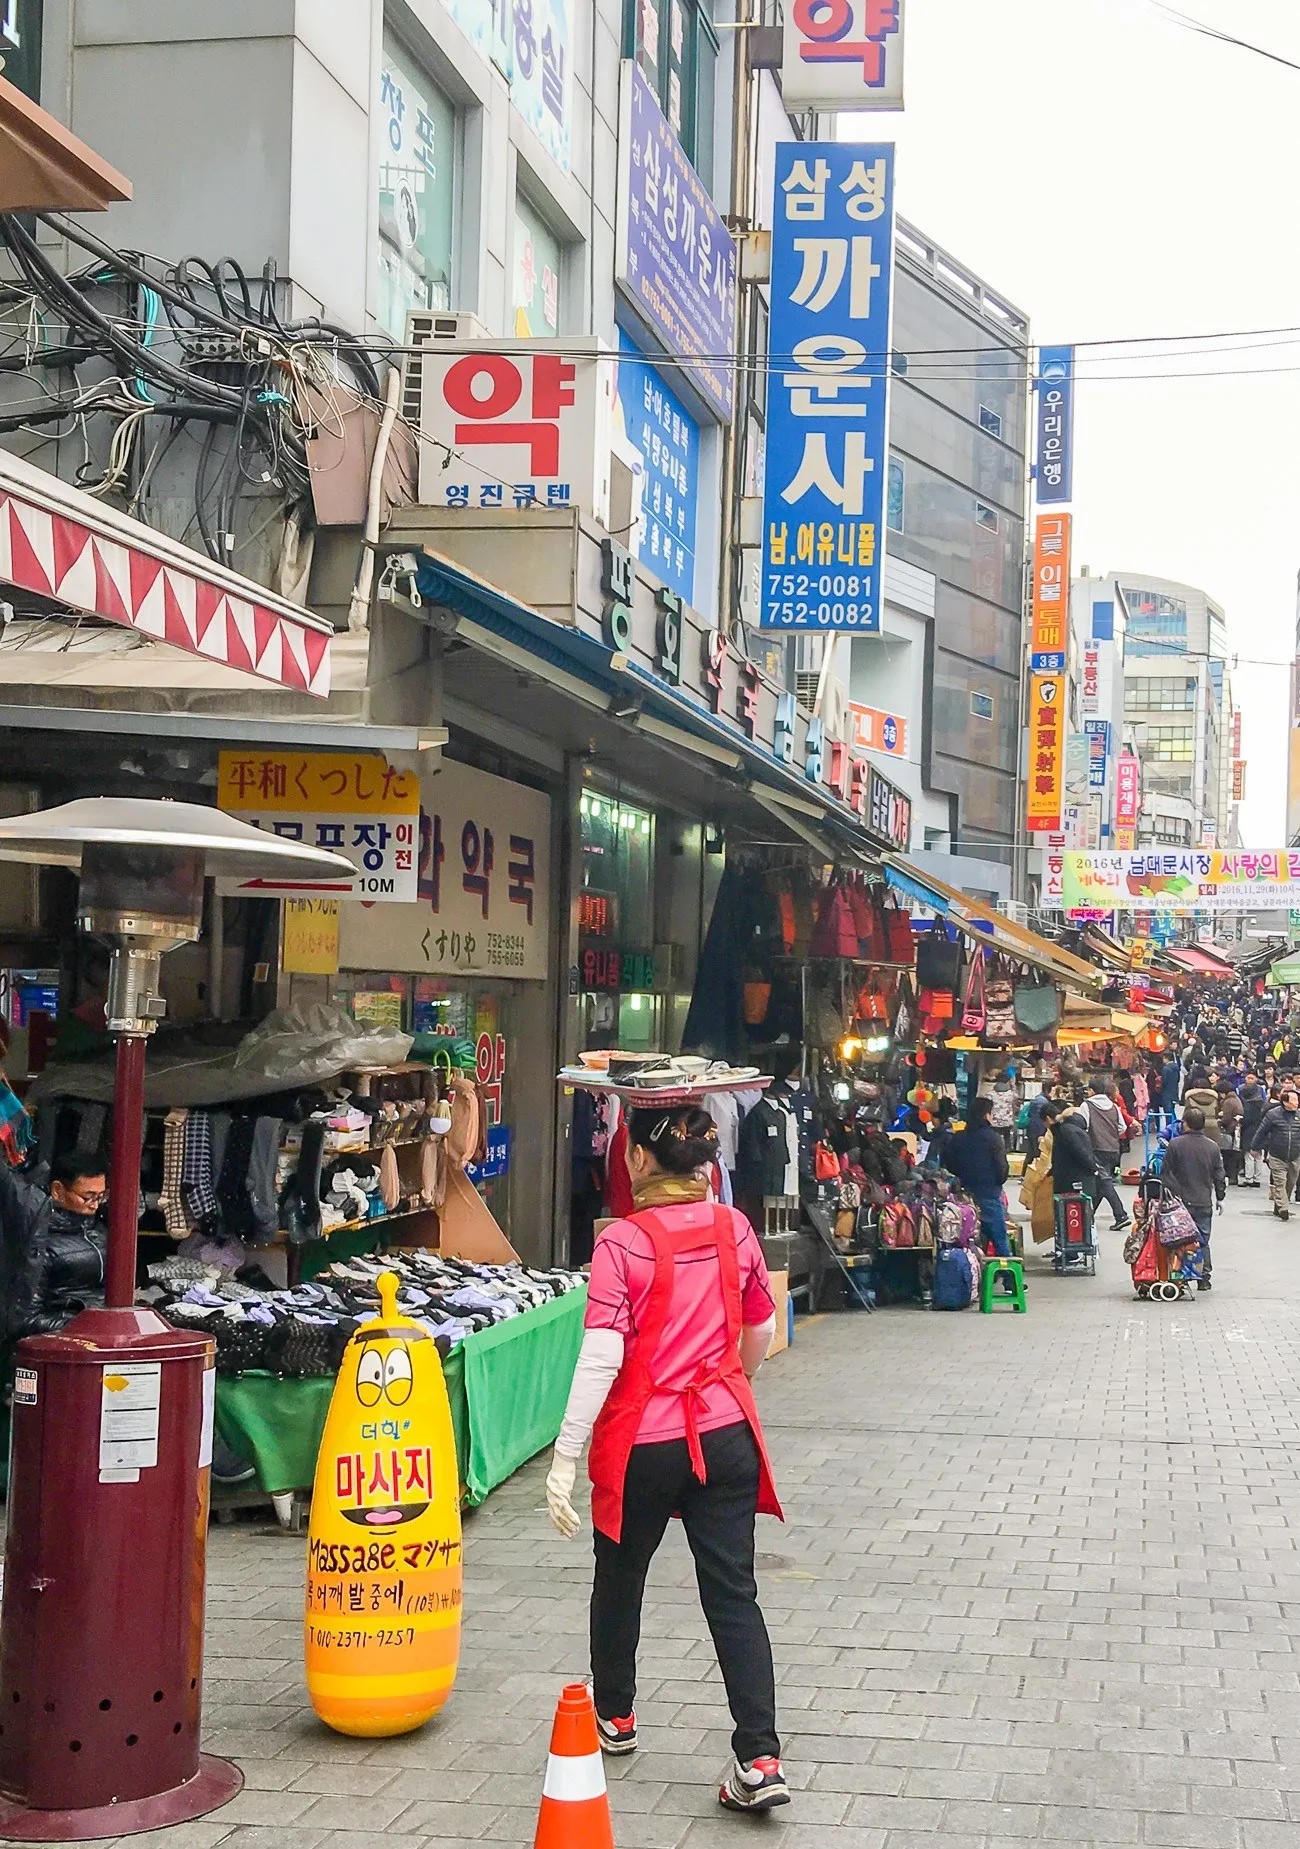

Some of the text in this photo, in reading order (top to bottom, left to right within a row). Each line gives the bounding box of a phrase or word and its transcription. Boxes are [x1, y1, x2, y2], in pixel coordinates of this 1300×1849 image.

[793, 0, 898, 87] 약
[778, 158, 886, 222] 삼성
[643, 130, 727, 322] 삼성까운사
[442, 354, 576, 477] 약
[1042, 390, 1064, 486] 우리은행
[445, 484, 571, 509] 영진큐텐
[767, 574, 872, 598] 752-0081
[767, 602, 873, 626] 752-0082
[1037, 609, 1061, 645] 도매
[1039, 655, 1059, 668] 3층
[1083, 651, 1098, 697] 부동산
[228, 759, 409, 800] 平和くつした
[1119, 765, 1134, 815] 미용재료
[394, 823, 414, 870] 이전
[1076, 857, 1123, 870] 2016년
[1130, 855, 1212, 877] 남대문시장
[1220, 853, 1279, 879] 사랑의
[358, 877, 395, 893] 10M
[420, 927, 476, 964] くすりや
[475, 1032, 506, 1125] 약
[336, 1447, 434, 1507] 마사지
[316, 1627, 415, 1649] 010-2371-9257
